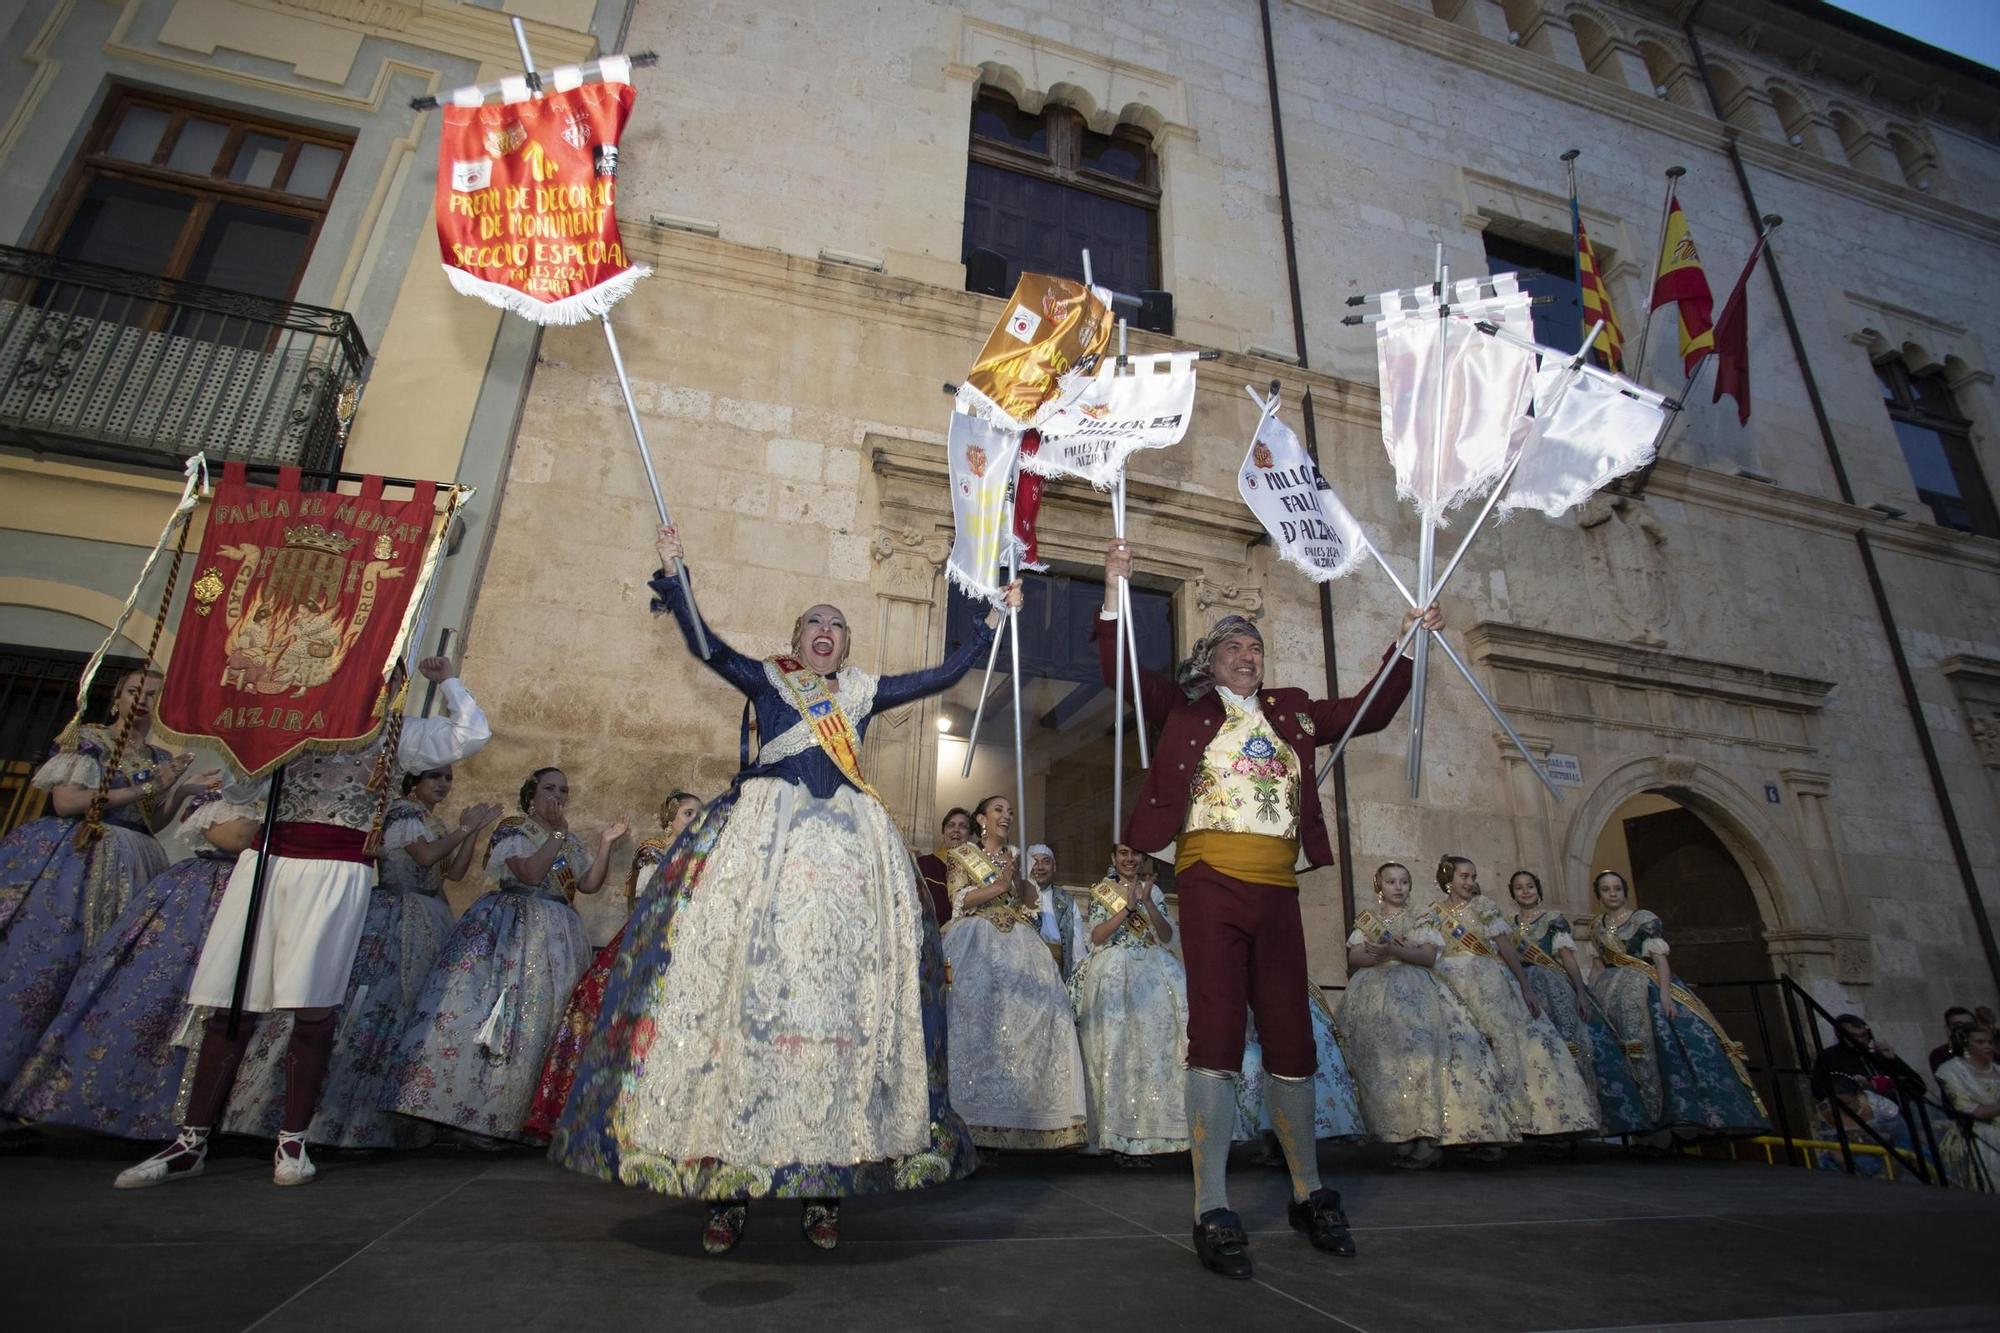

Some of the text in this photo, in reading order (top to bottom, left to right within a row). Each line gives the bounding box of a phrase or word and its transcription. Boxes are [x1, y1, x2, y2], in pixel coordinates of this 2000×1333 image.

[450, 182, 616, 217] PREMI DE DECORAC
[480, 208, 606, 241] DE MONUMENT
[452, 238, 528, 268] SECCIÓ
[523, 278, 570, 294] ALZIRA
[553, 266, 584, 280] 2024
[1264, 465, 1316, 491] MILLO
[215, 498, 423, 544] FALLA EL MERCAT
[213, 707, 325, 732] ALZIRA
